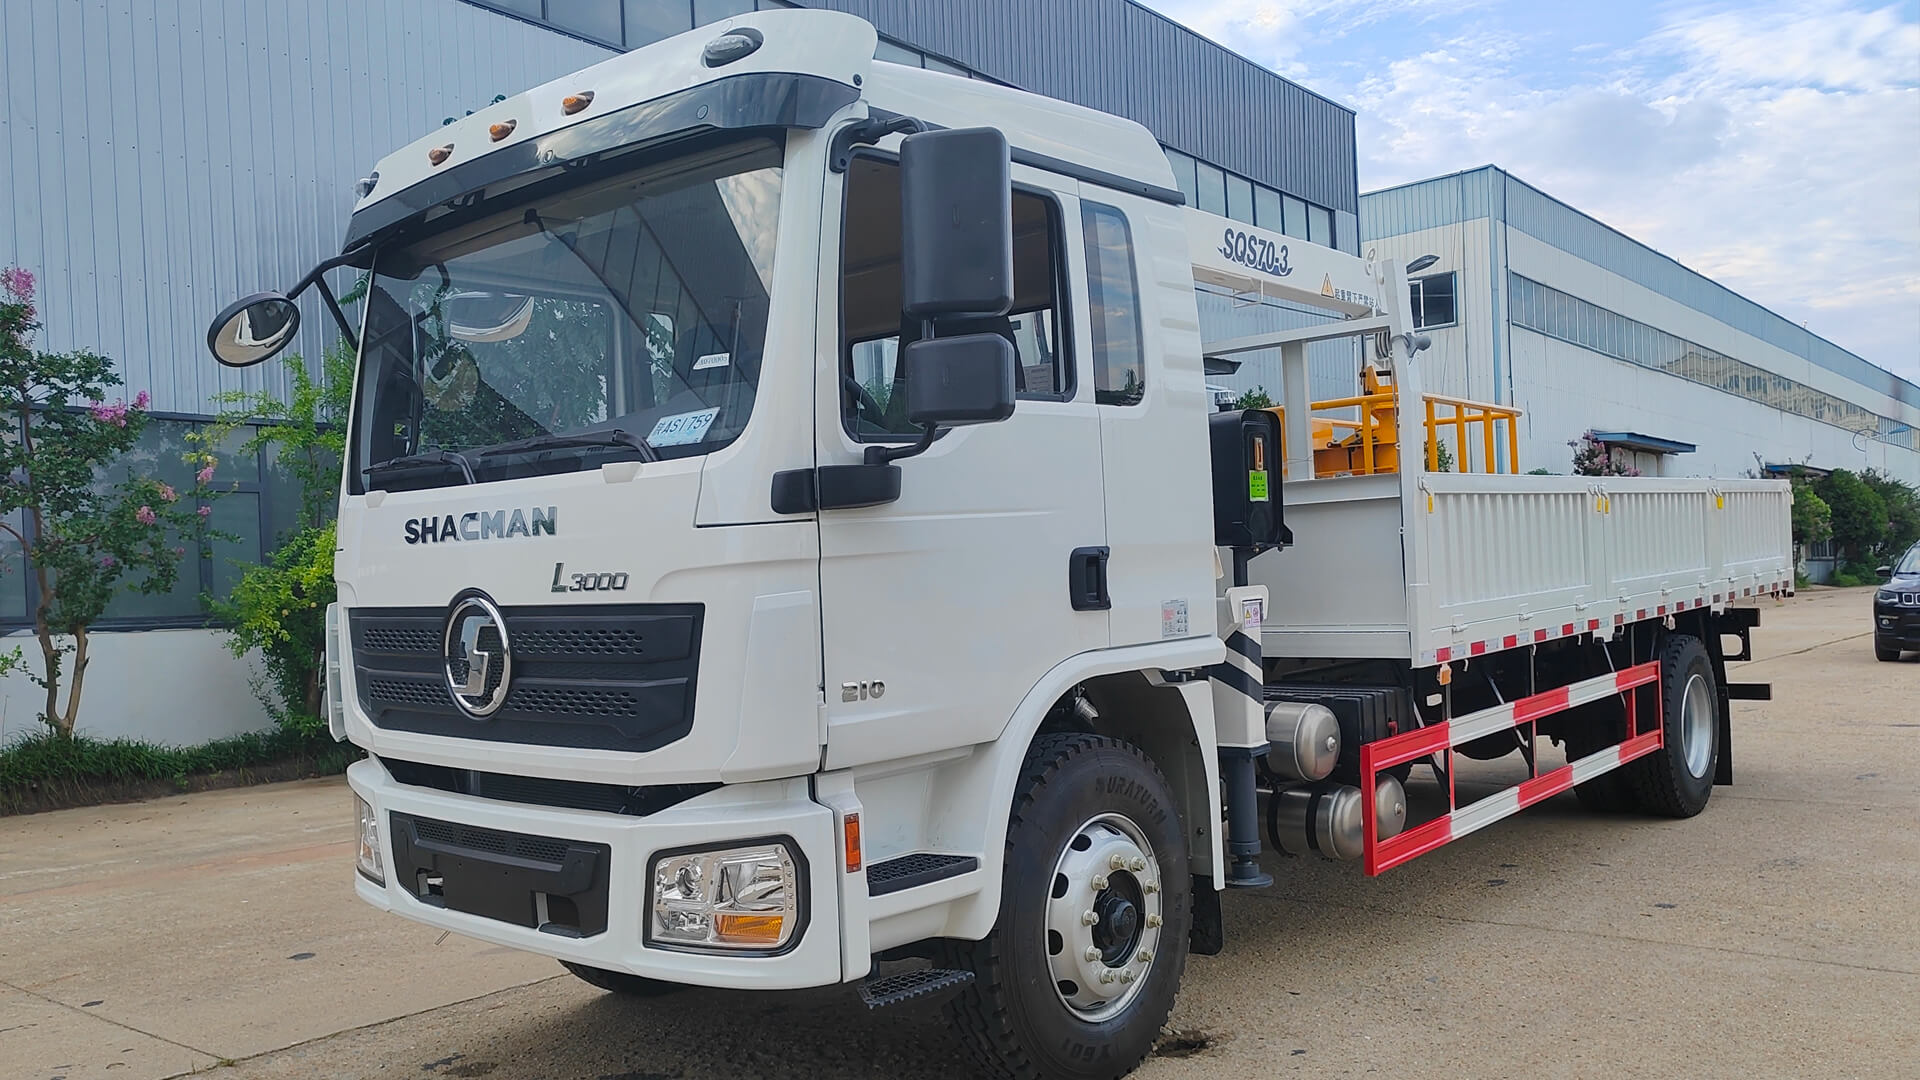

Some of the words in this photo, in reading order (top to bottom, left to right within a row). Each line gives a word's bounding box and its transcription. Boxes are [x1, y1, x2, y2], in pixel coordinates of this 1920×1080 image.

[1223, 228, 1289, 274] SQS70-3
[404, 506, 557, 544] SHACMAN
[551, 562, 629, 593] L3000
[842, 680, 885, 702] 210
